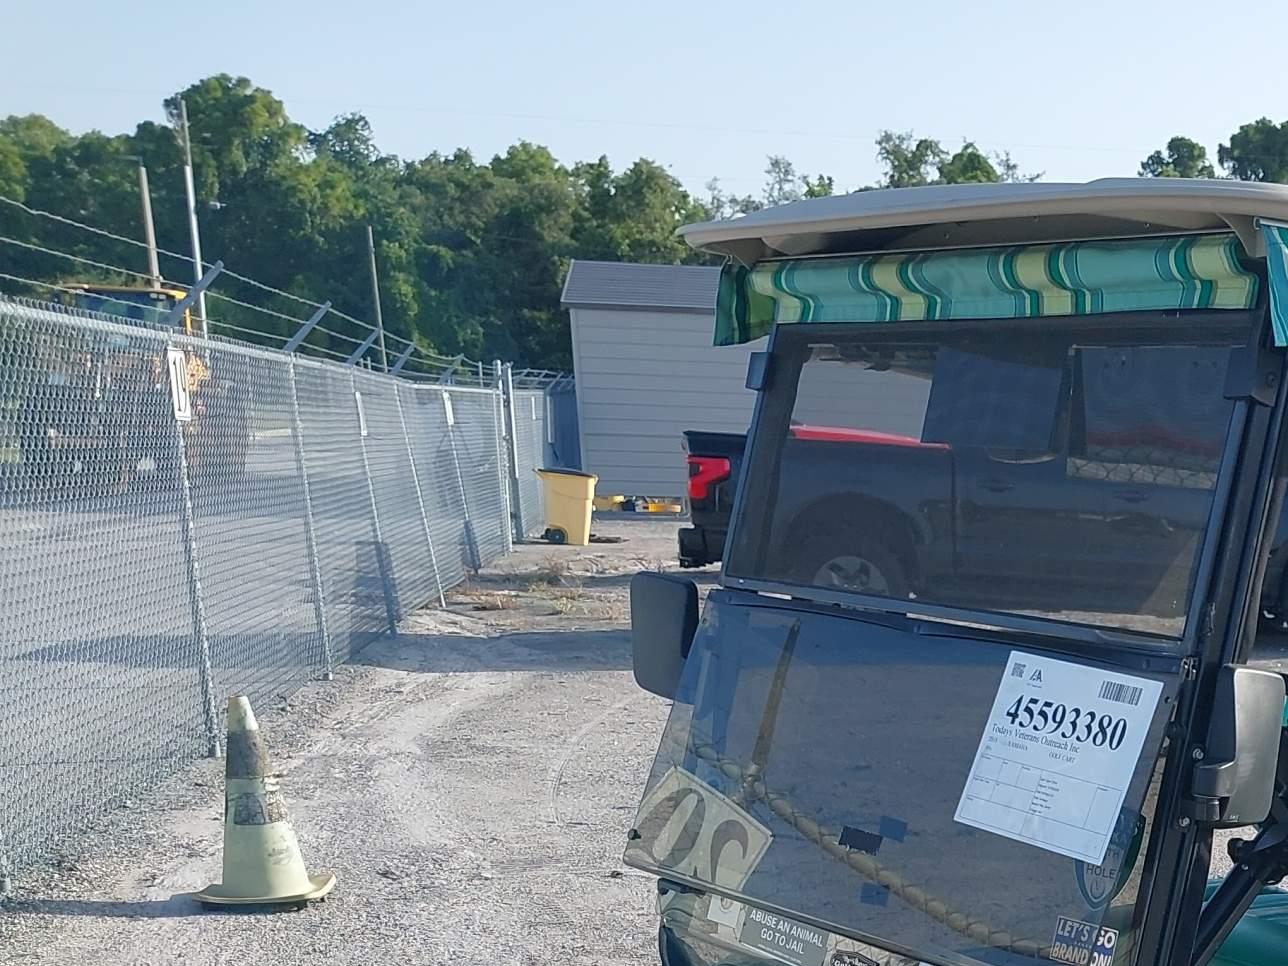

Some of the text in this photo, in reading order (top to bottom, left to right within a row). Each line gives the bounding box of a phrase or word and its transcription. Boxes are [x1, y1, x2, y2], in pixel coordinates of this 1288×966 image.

[1006, 694, 1127, 751] 45593380
[1014, 729, 1040, 745] Veterans
[1041, 735, 1068, 751] Outreach
[1069, 742, 1081, 754] Inc
[1086, 864, 1118, 880] HOLE
[750, 909, 824, 948] ABUSE AN ANIMAL
[760, 928, 774, 942] GO
[774, 932, 786, 946] TO
[785, 938, 805, 955] JAIL
[1057, 919, 1091, 942] LET'S
[1092, 928, 1116, 949] GO
